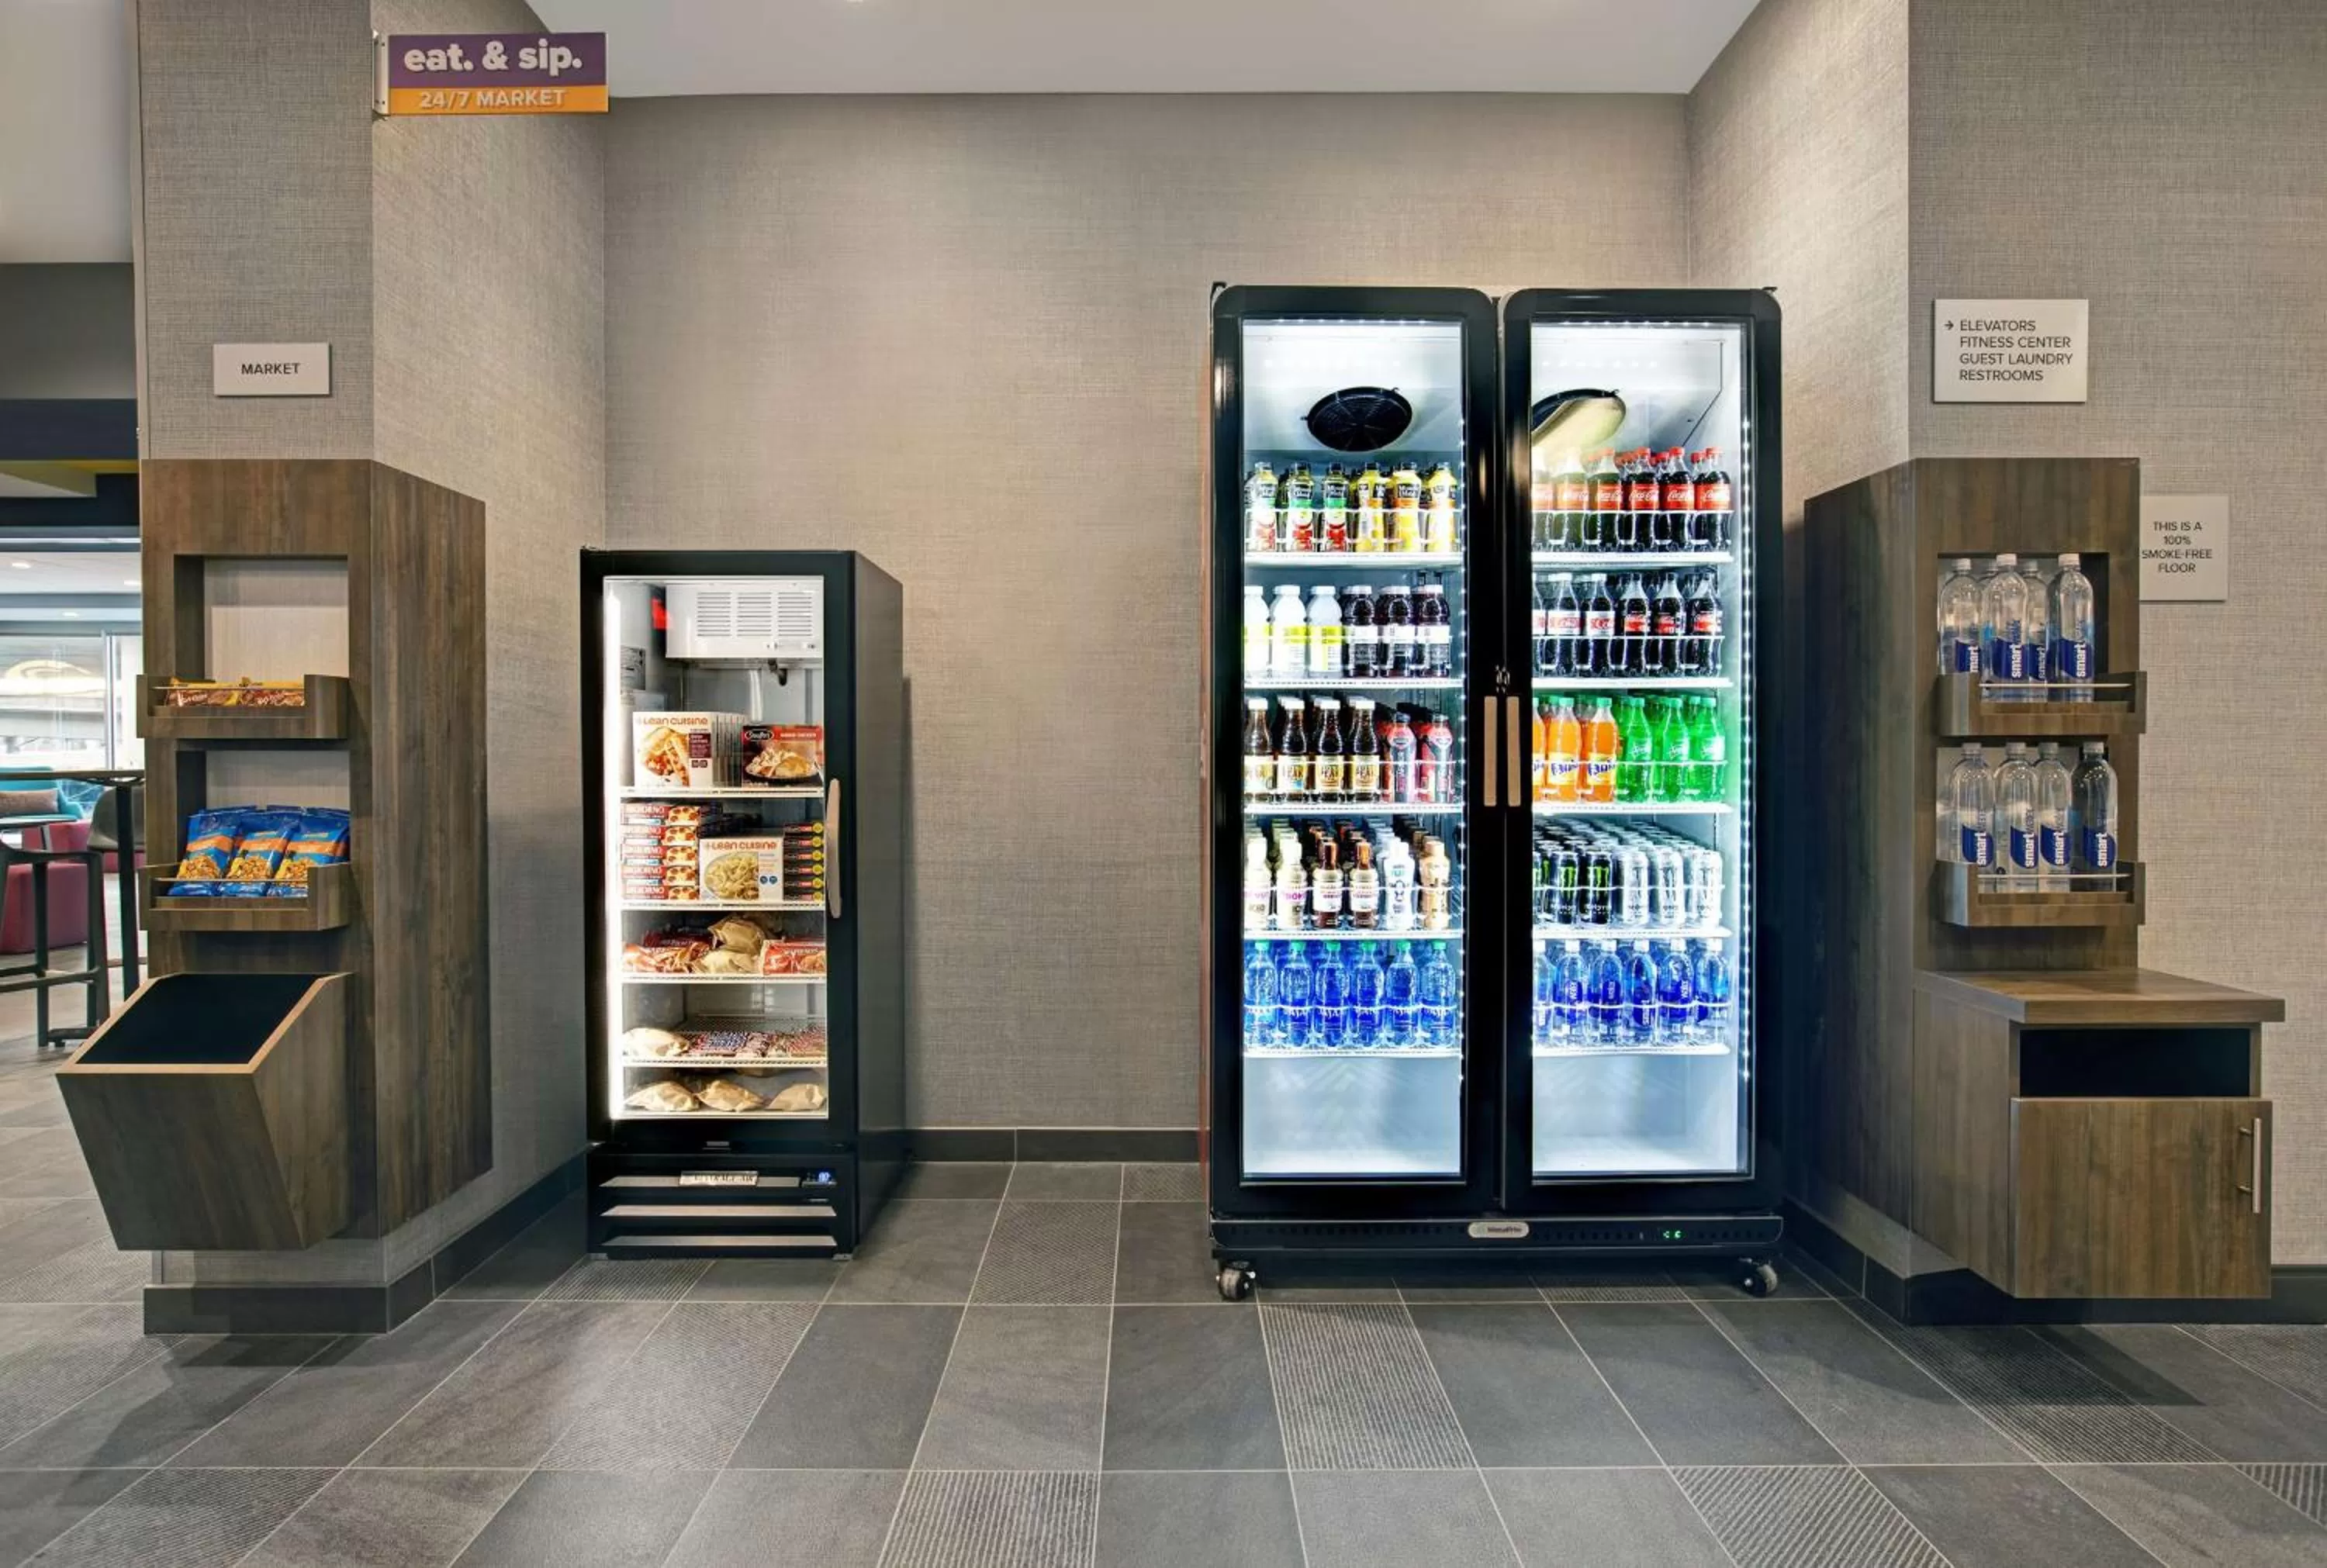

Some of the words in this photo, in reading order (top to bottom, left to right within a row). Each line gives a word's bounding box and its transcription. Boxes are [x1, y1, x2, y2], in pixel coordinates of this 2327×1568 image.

[404, 43, 473, 71] eat.
[482, 40, 508, 70] &
[518, 38, 582, 76] sip.
[419, 90, 469, 109] 24/7
[476, 89, 567, 107] MARKET
[1960, 319, 2036, 332] ELEVATORS
[1960, 336, 2014, 348] FITNESS
[2018, 336, 2071, 348] CENTER
[1959, 353, 2004, 365] GUEST
[2008, 353, 2073, 365] LAUNDRY
[241, 362, 300, 375] MARKET
[1959, 369, 2044, 381] RESTROOMS
[2153, 521, 2178, 531] THIS
[2180, 521, 2191, 531] IS
[2194, 521, 2202, 531] A
[2163, 536, 2191, 545] 100%
[2142, 548, 2213, 559] SMOKE-FREE
[2158, 563, 2196, 573] FLOOR
[1969, 645, 1979, 672] mart
[1975, 831, 1986, 866] smart
[2023, 833, 2035, 868] smart
[2053, 831, 2064, 865] smart
[2096, 832, 2107, 867] smart
